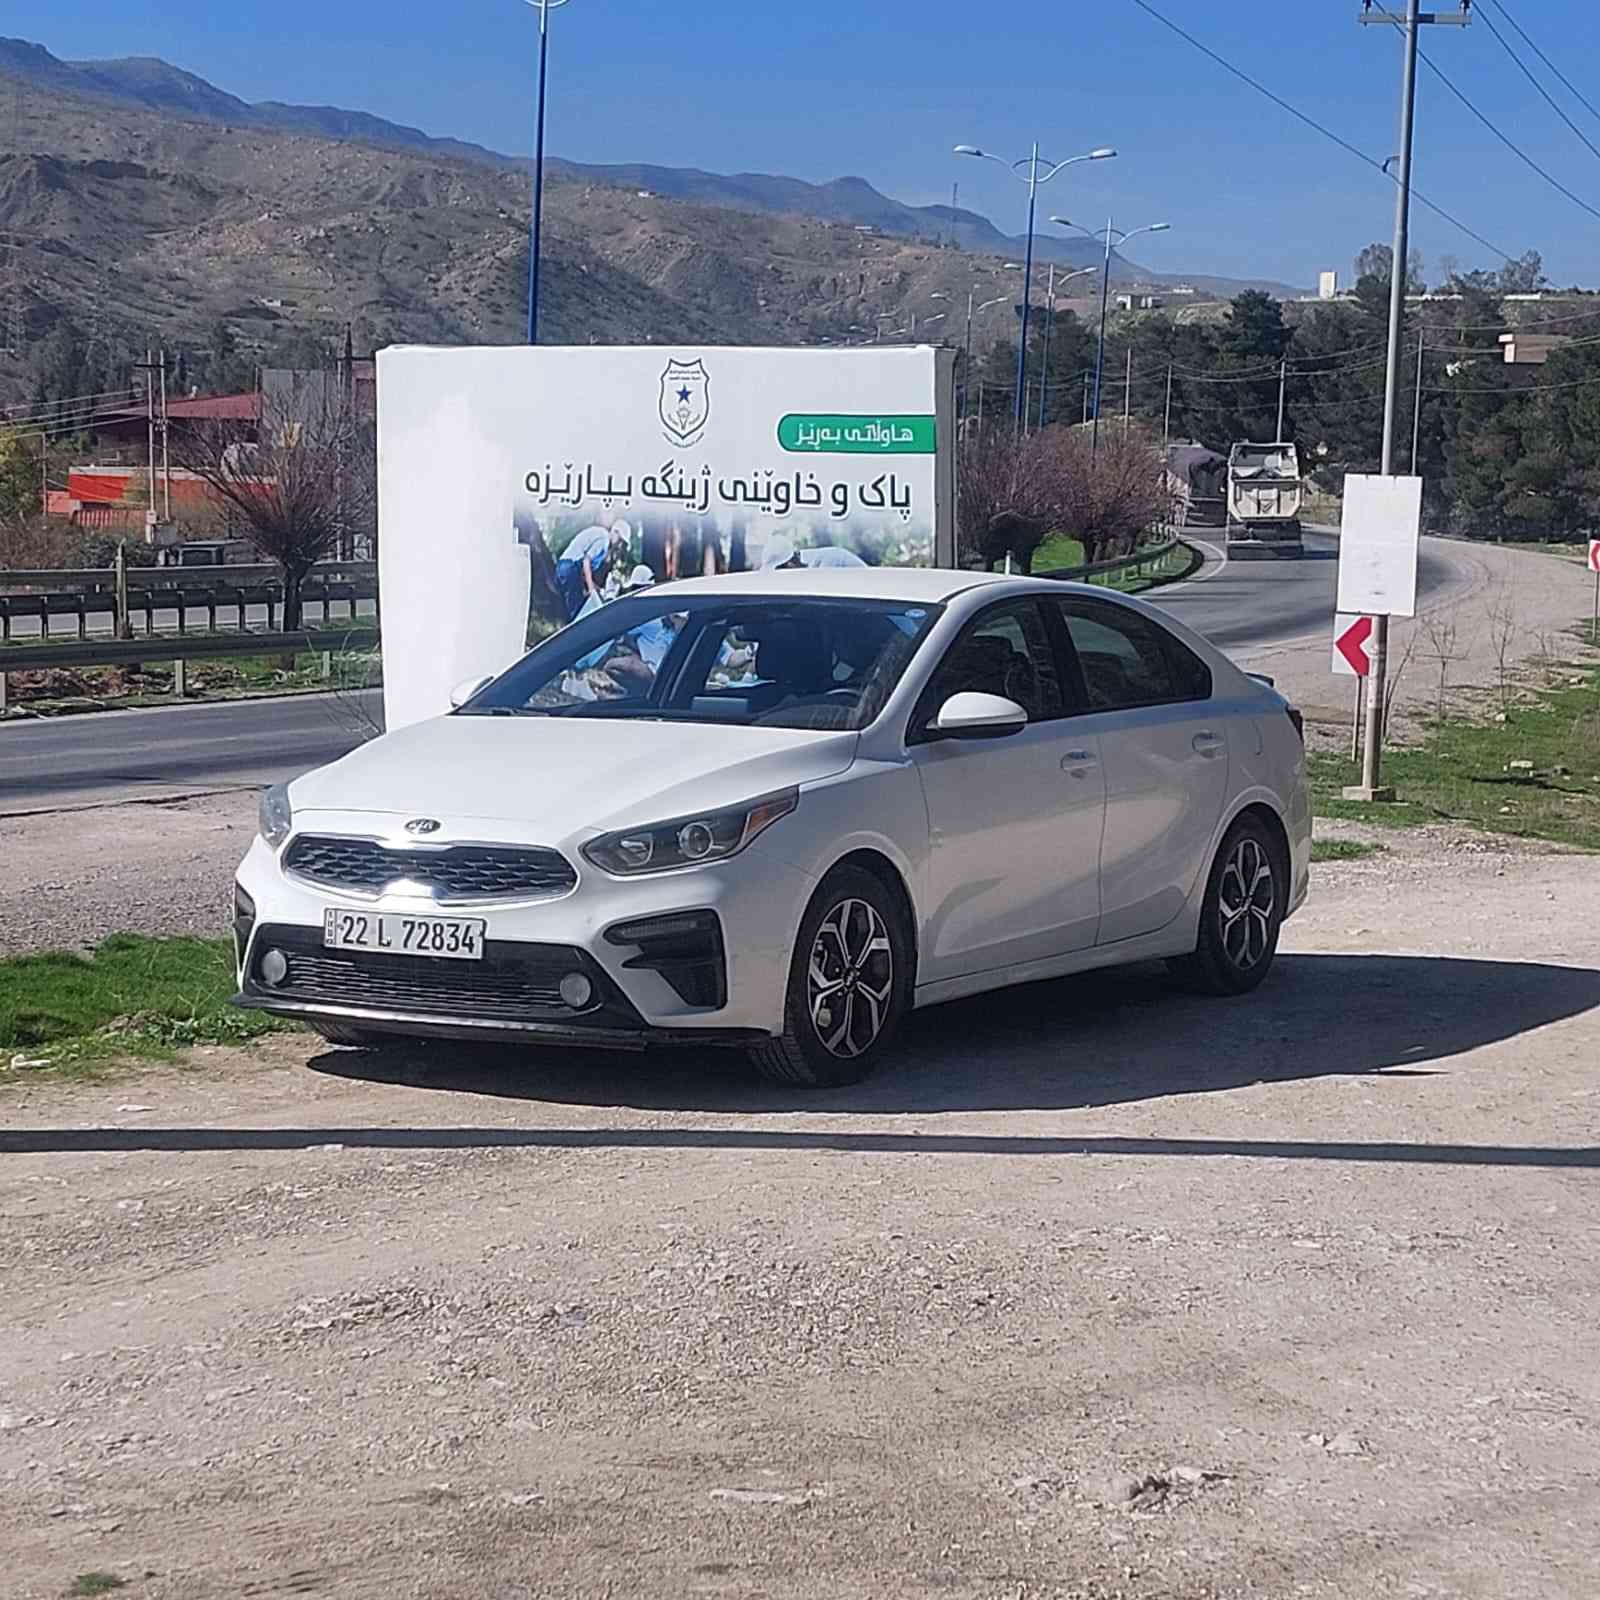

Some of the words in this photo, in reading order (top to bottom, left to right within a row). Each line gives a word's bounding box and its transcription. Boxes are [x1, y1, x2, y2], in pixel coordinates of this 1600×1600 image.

[795, 421, 841, 450] بەڕێز
[844, 417, 914, 447] هاوڵاتی
[525, 463, 632, 509] بپارێزە
[641, 458, 711, 512] ژینگە
[718, 468, 822, 515] خاوێنی
[831, 482, 849, 517] و
[859, 472, 911, 521] پاک
[342, 914, 369, 945] 22
[377, 917, 392, 947] L
[402, 919, 476, 954] 72834
